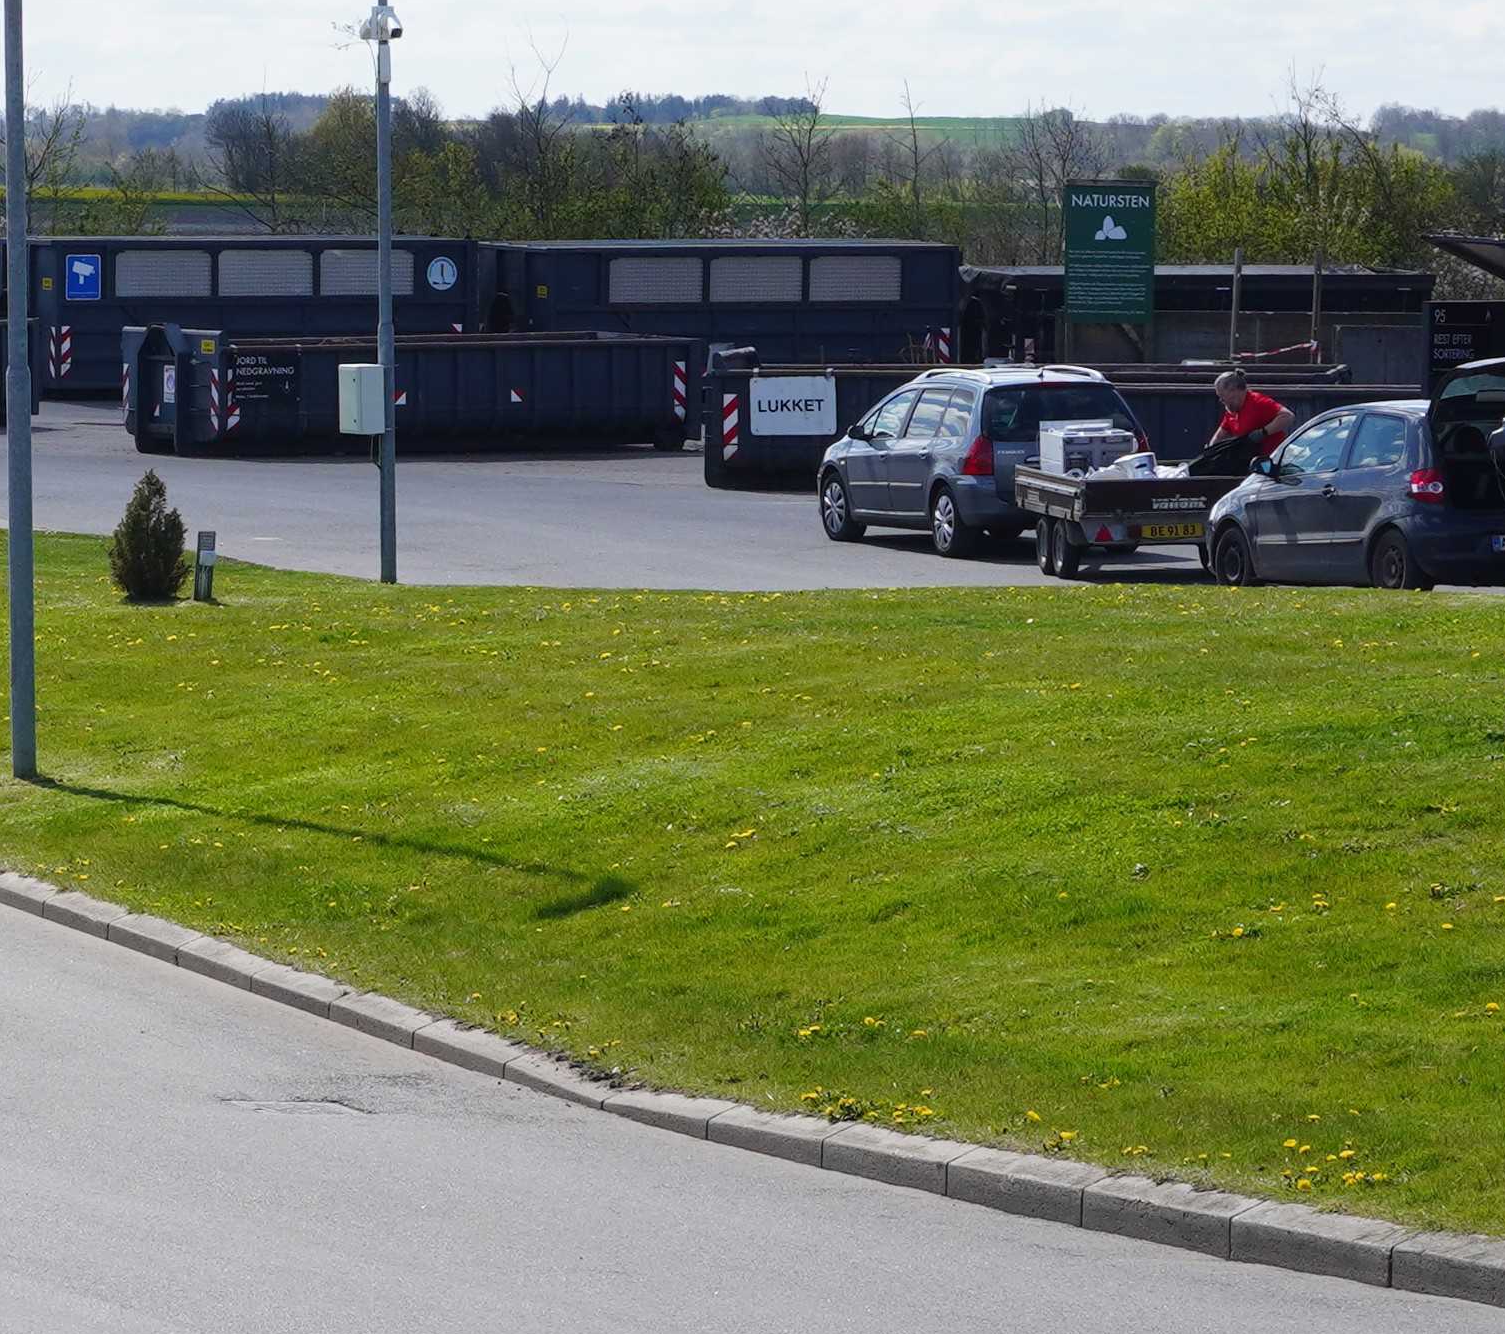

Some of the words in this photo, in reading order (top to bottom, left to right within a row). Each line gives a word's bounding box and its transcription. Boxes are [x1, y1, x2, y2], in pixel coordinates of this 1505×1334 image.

[1071, 194, 1150, 208] NATURSTEN
[1434, 309, 1447, 323] 95
[1433, 333, 1450, 345] REST
[1433, 348, 1475, 360] SORTERING
[236, 356, 256, 365] JORD
[258, 356, 268, 365] TIL
[236, 367, 295, 376] NEDGRAVNING
[757, 398, 824, 413] LUKKET
